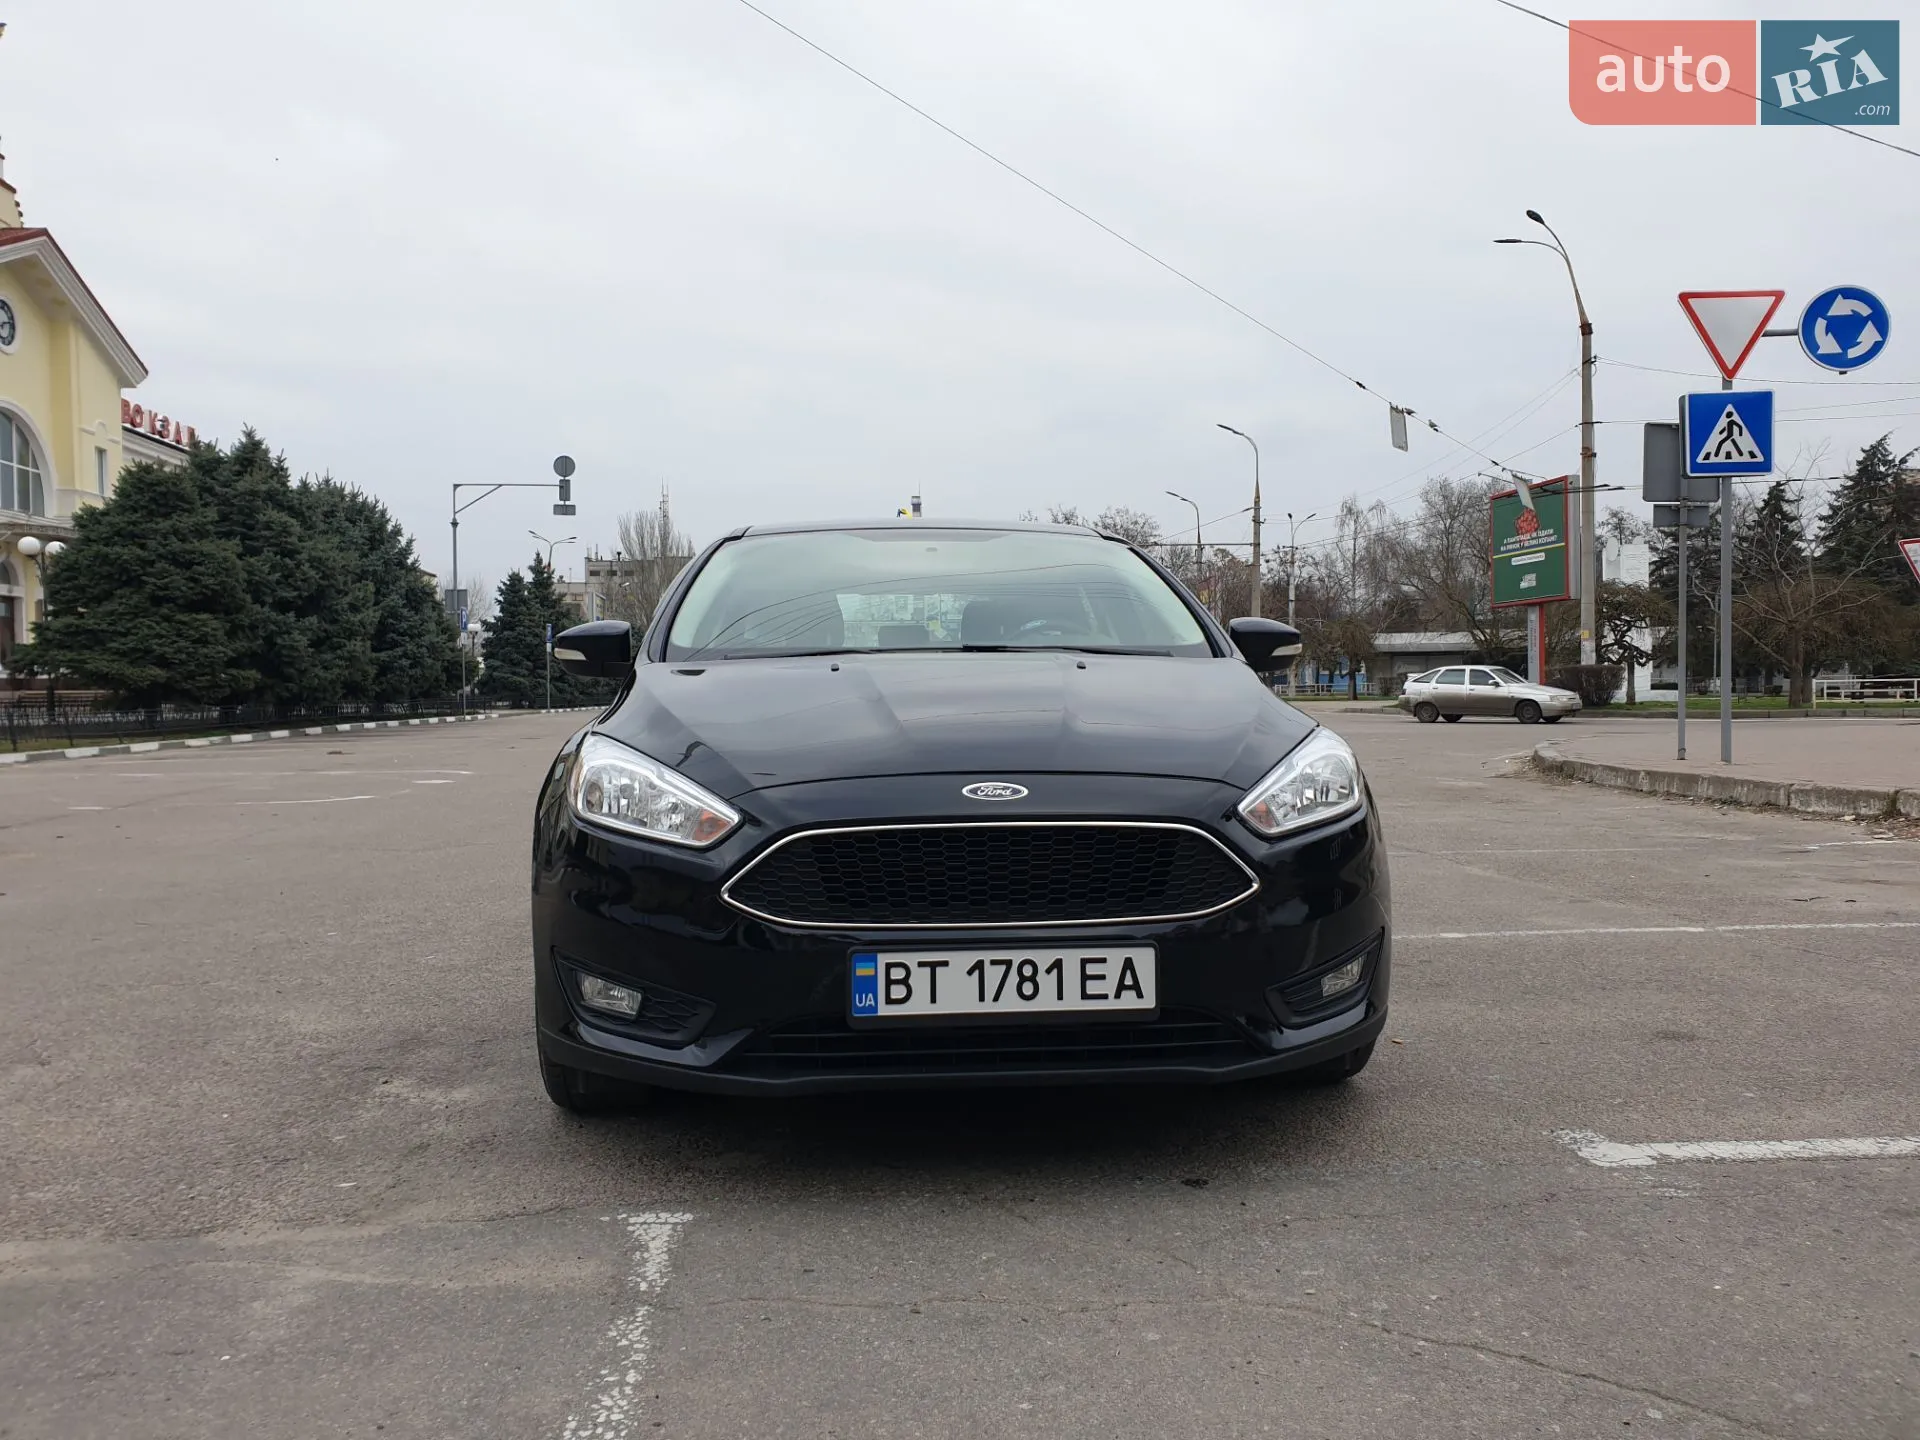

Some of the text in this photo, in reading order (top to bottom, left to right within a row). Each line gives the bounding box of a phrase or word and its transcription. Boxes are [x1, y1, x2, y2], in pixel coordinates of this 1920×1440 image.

[977, 786, 1013, 796] Ford
[884, 956, 1145, 1006] BT 1781 EA
[855, 993, 876, 1008] UA
